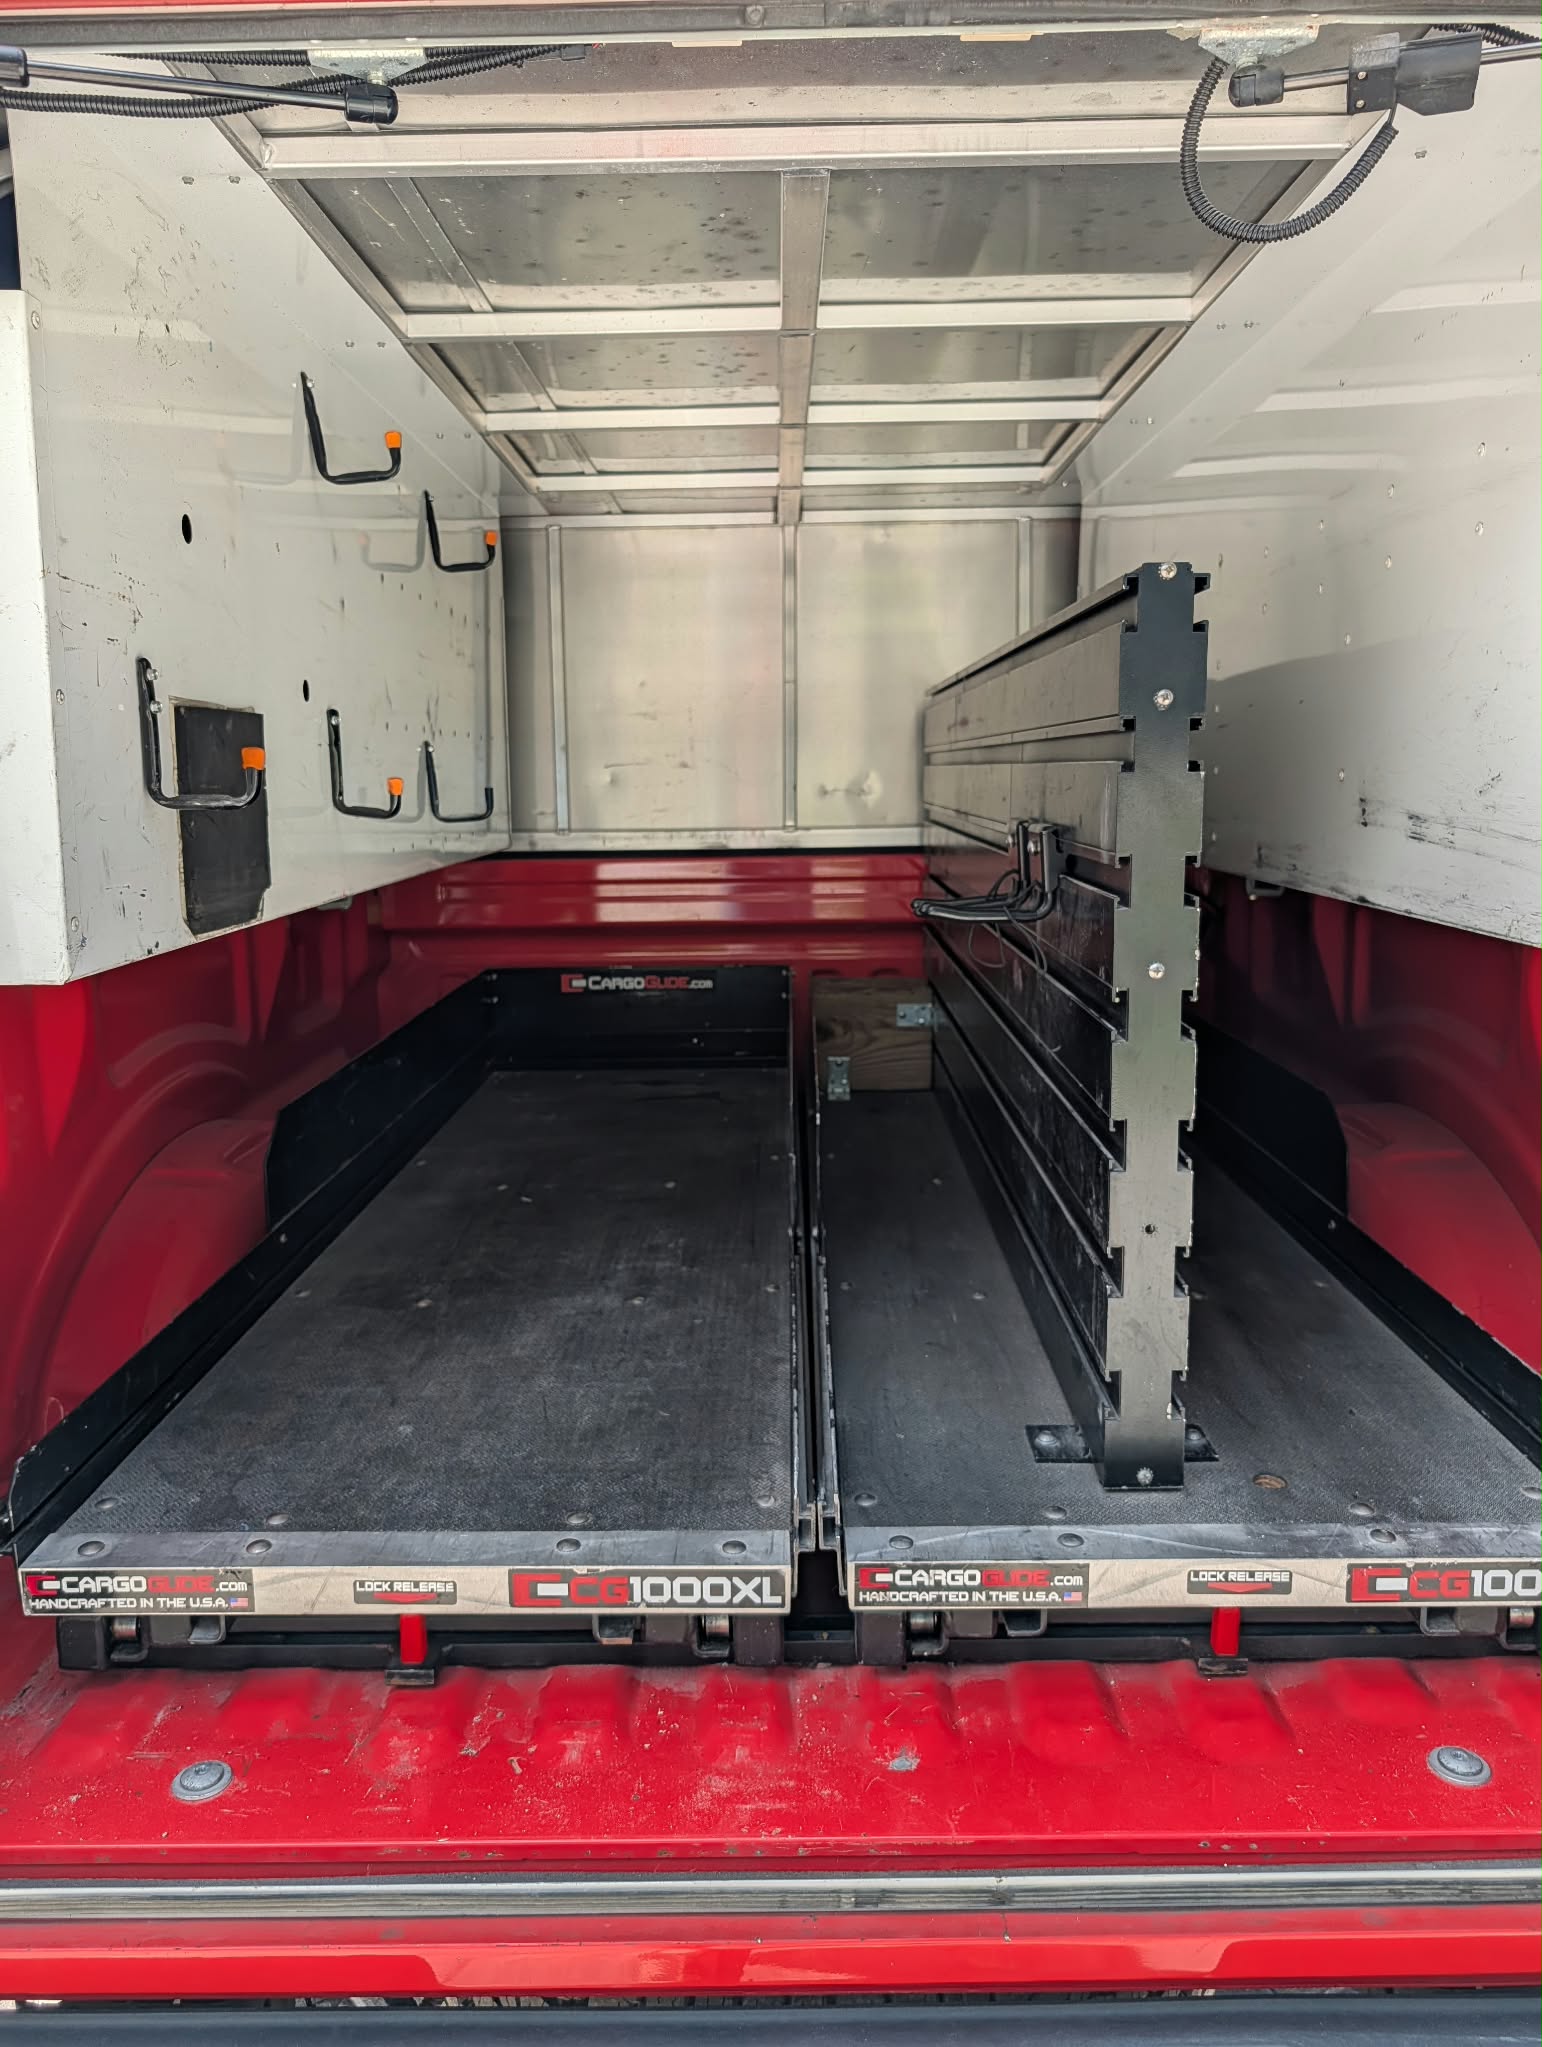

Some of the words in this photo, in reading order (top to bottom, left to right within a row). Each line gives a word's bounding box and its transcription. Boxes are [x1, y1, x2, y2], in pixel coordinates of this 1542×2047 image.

[1190, 1571, 1226, 1582] LOCK
[1228, 1571, 1290, 1582] RELEASE
[356, 1581, 391, 1592] LOCK
[393, 1581, 454, 1592] RELEASE
[569, 1576, 782, 1604] CG1000XL
[859, 1591, 969, 1602] HANDCRAFTED
[972, 1591, 986, 1601] IN
[990, 1591, 1019, 1601] THE
[1022, 1591, 1062, 1601] U.S.A.
[31, 1598, 137, 1609] HANDCRAFTED
[140, 1598, 153, 1609] IN
[156, 1597, 187, 1608] THE
[190, 1597, 229, 1608] U.S.A.
